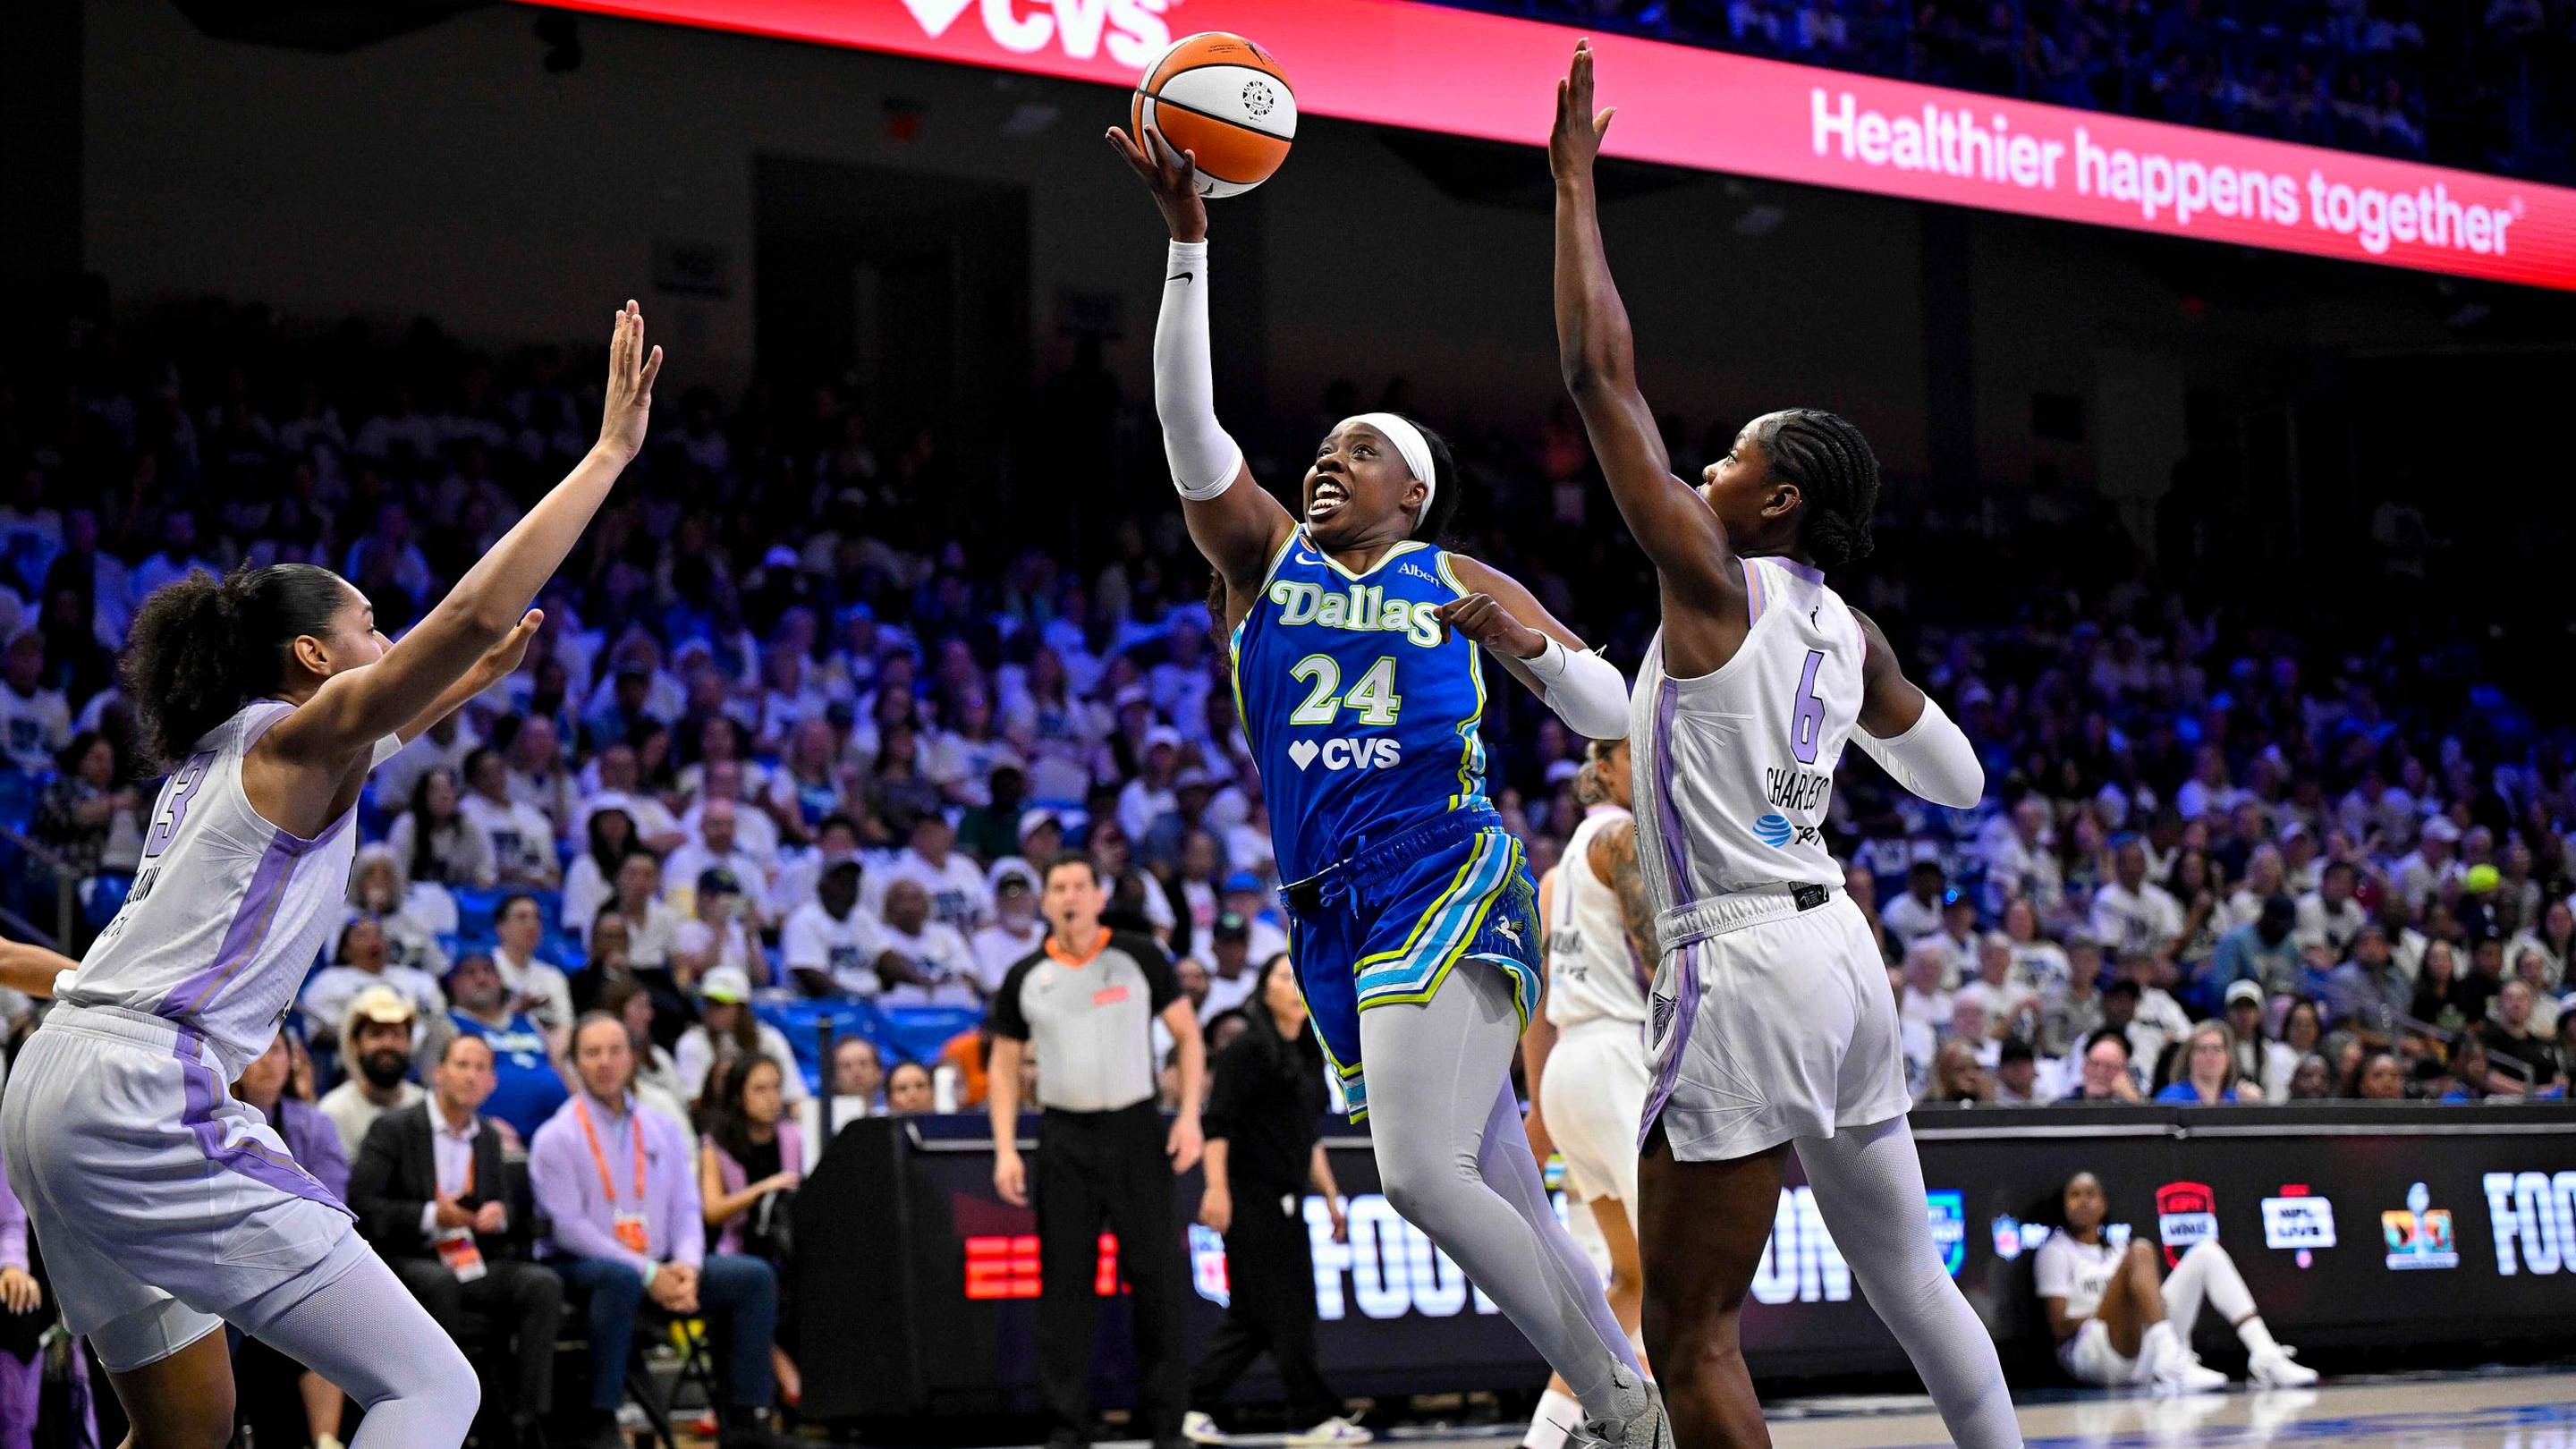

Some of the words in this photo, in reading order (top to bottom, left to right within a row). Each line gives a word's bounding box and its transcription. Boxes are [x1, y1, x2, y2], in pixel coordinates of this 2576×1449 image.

[1810, 88, 2063, 190] Healthier
[2075, 125, 2300, 225] happens
[1269, 580, 1443, 648] Dallas
[1290, 654, 1402, 725] 24
[1790, 649, 1826, 765] 6
[1322, 739, 1401, 769] CVS
